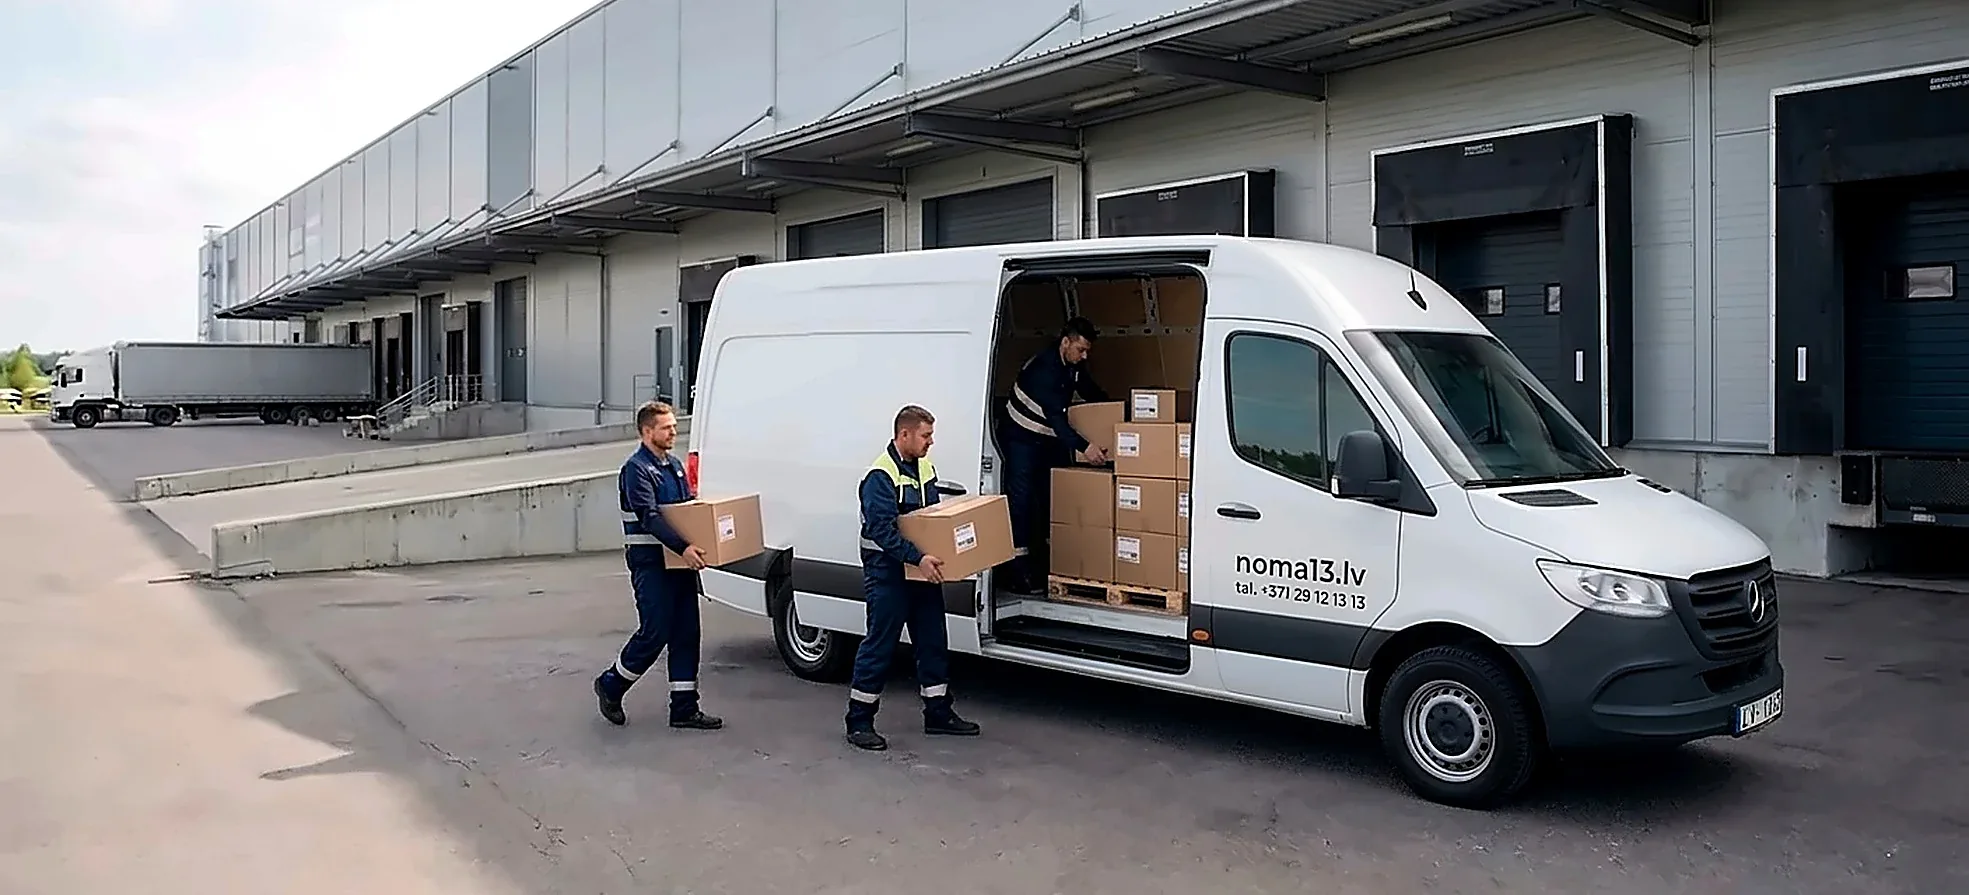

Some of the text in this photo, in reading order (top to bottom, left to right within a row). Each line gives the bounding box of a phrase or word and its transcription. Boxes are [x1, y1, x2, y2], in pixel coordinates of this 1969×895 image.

[1236, 555, 1367, 586] noma13.lv
[1235, 581, 1366, 609] tal. +371 29 12 13 13
